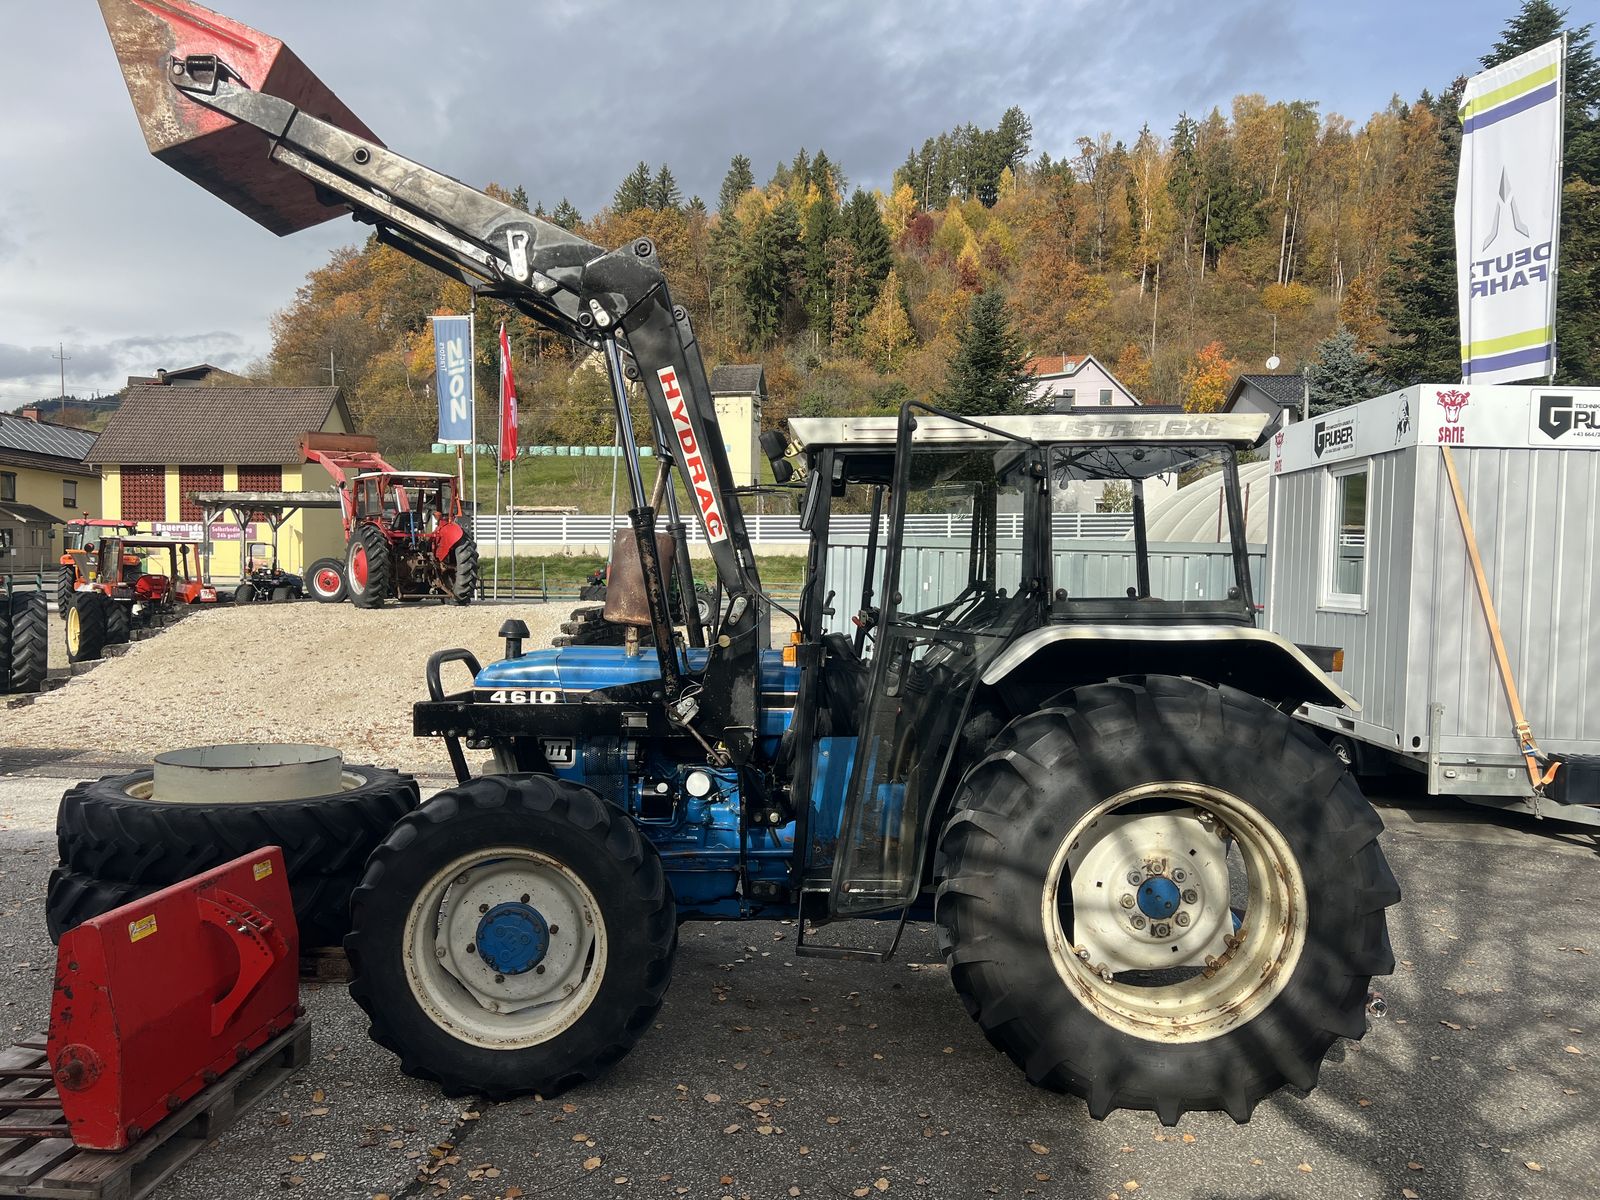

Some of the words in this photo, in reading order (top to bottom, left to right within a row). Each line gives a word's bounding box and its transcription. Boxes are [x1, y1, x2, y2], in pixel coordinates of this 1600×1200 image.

[1438, 427, 1464, 443] SAME
[660, 371, 723, 538] HYDRAC
[156, 523, 203, 532] Bauernlade
[490, 691, 557, 704] 4610
